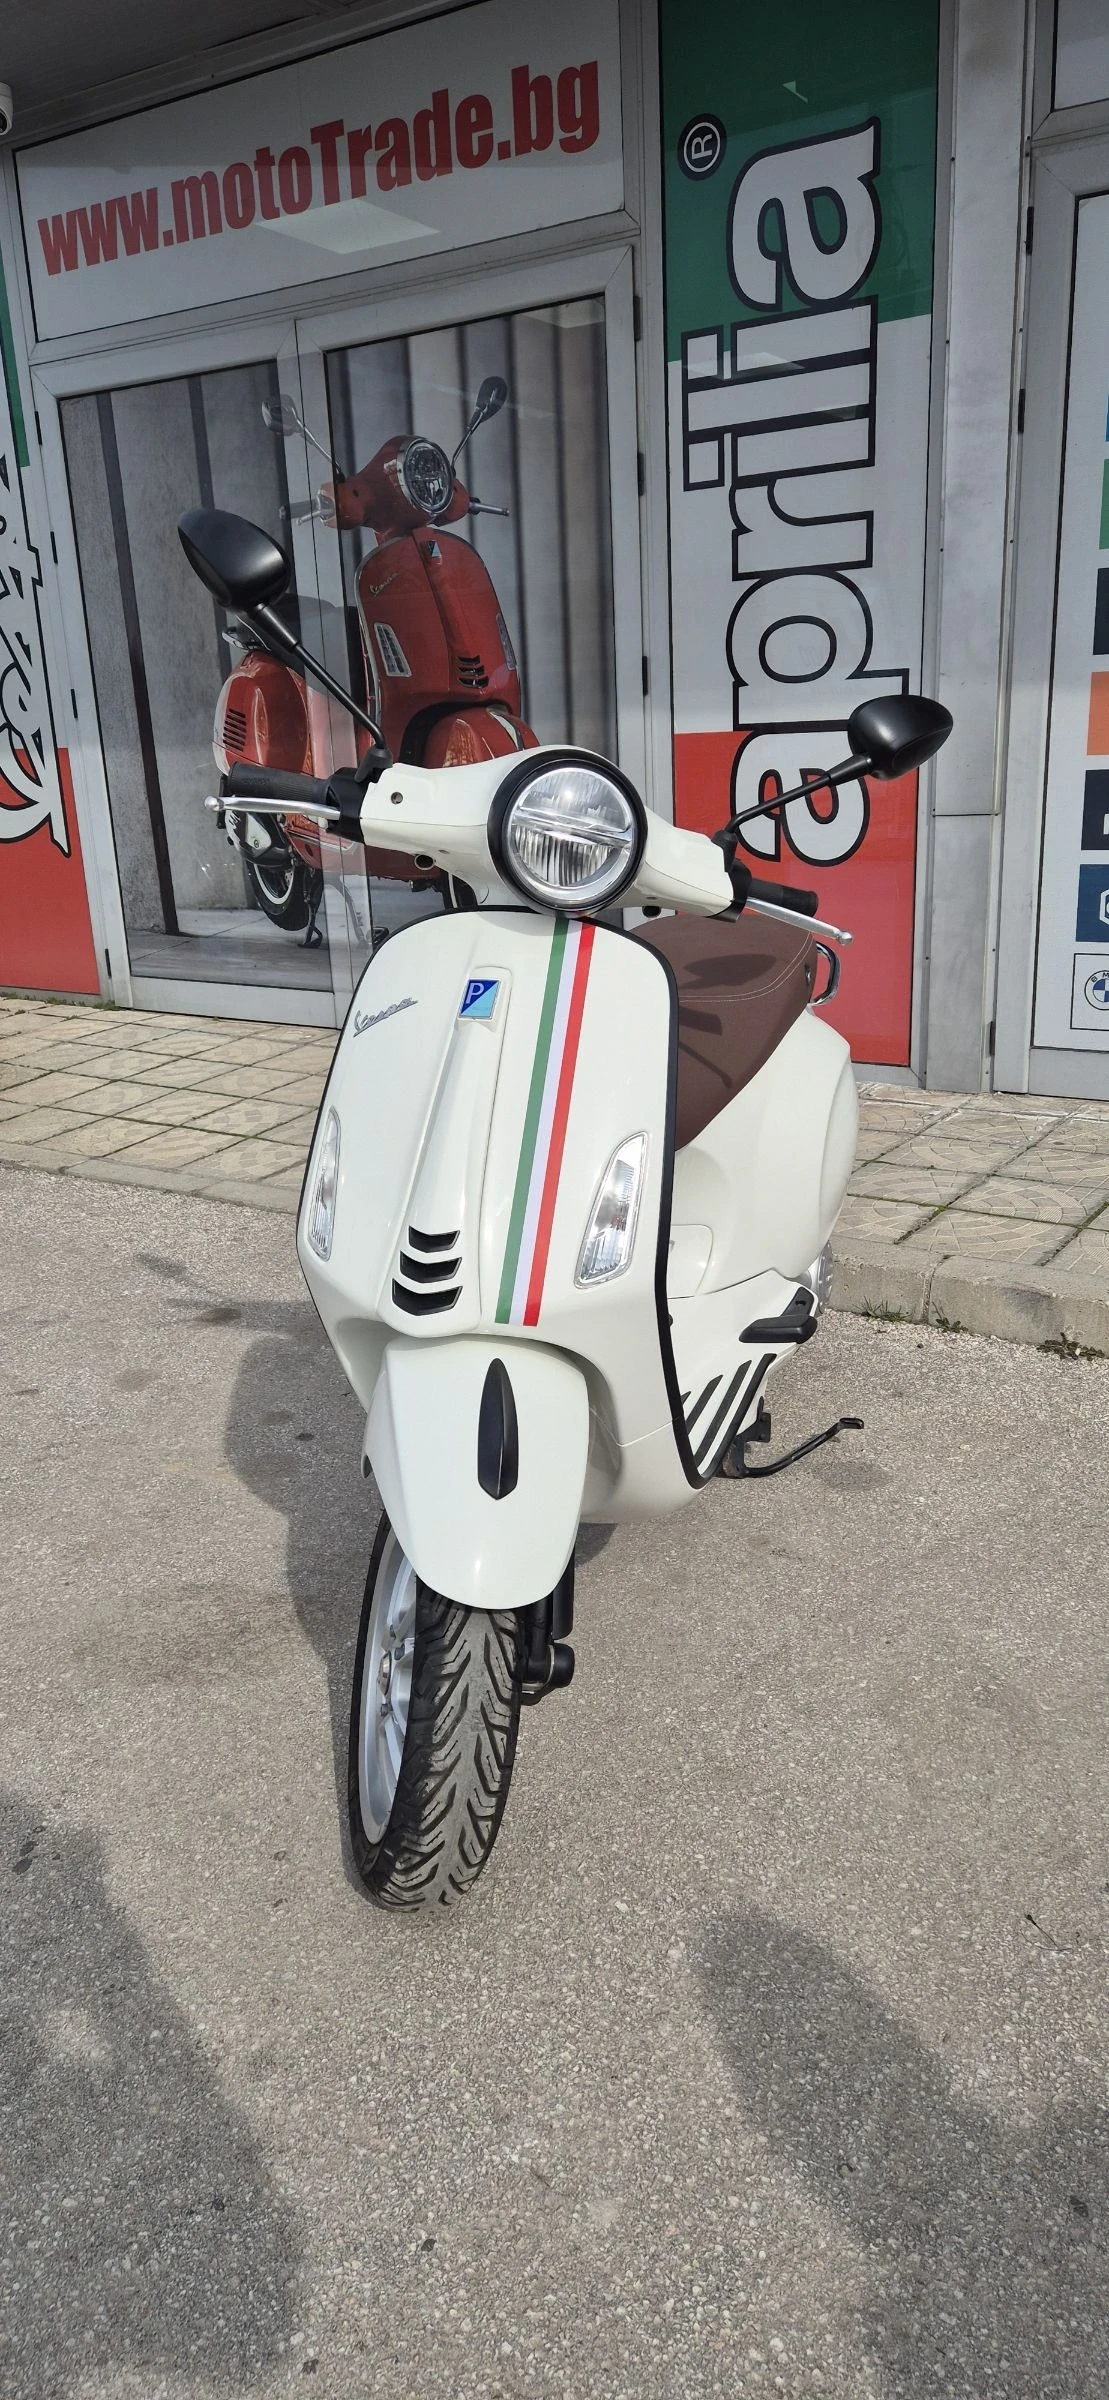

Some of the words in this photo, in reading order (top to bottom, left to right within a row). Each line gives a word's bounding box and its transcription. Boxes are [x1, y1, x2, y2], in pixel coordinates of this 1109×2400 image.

[37, 60, 600, 276] www.motoTrade.bg
[681, 116, 909, 867] aprilia
[353, 997, 418, 1037] Vespa
